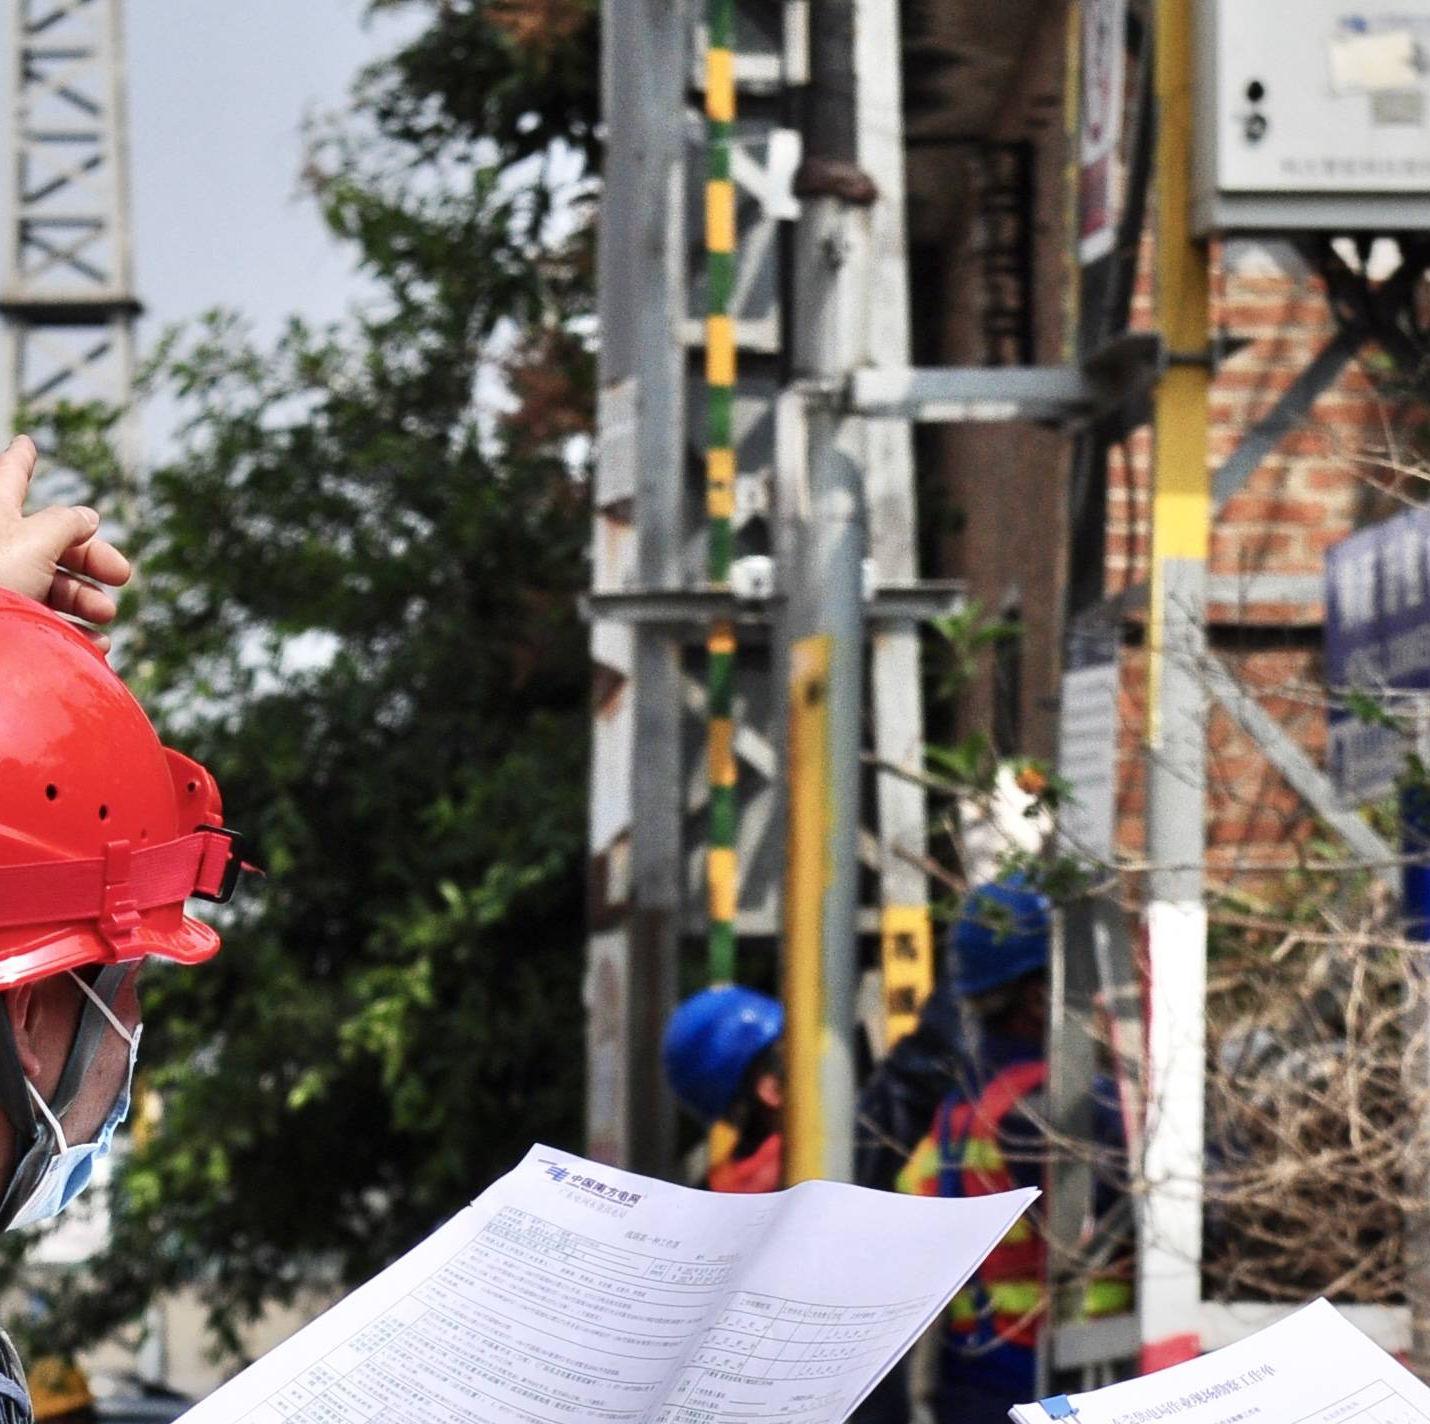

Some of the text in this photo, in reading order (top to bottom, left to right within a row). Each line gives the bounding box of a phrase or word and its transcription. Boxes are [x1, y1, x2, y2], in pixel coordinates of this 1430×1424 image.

[571, 1174, 643, 1206] 中国南方电网
